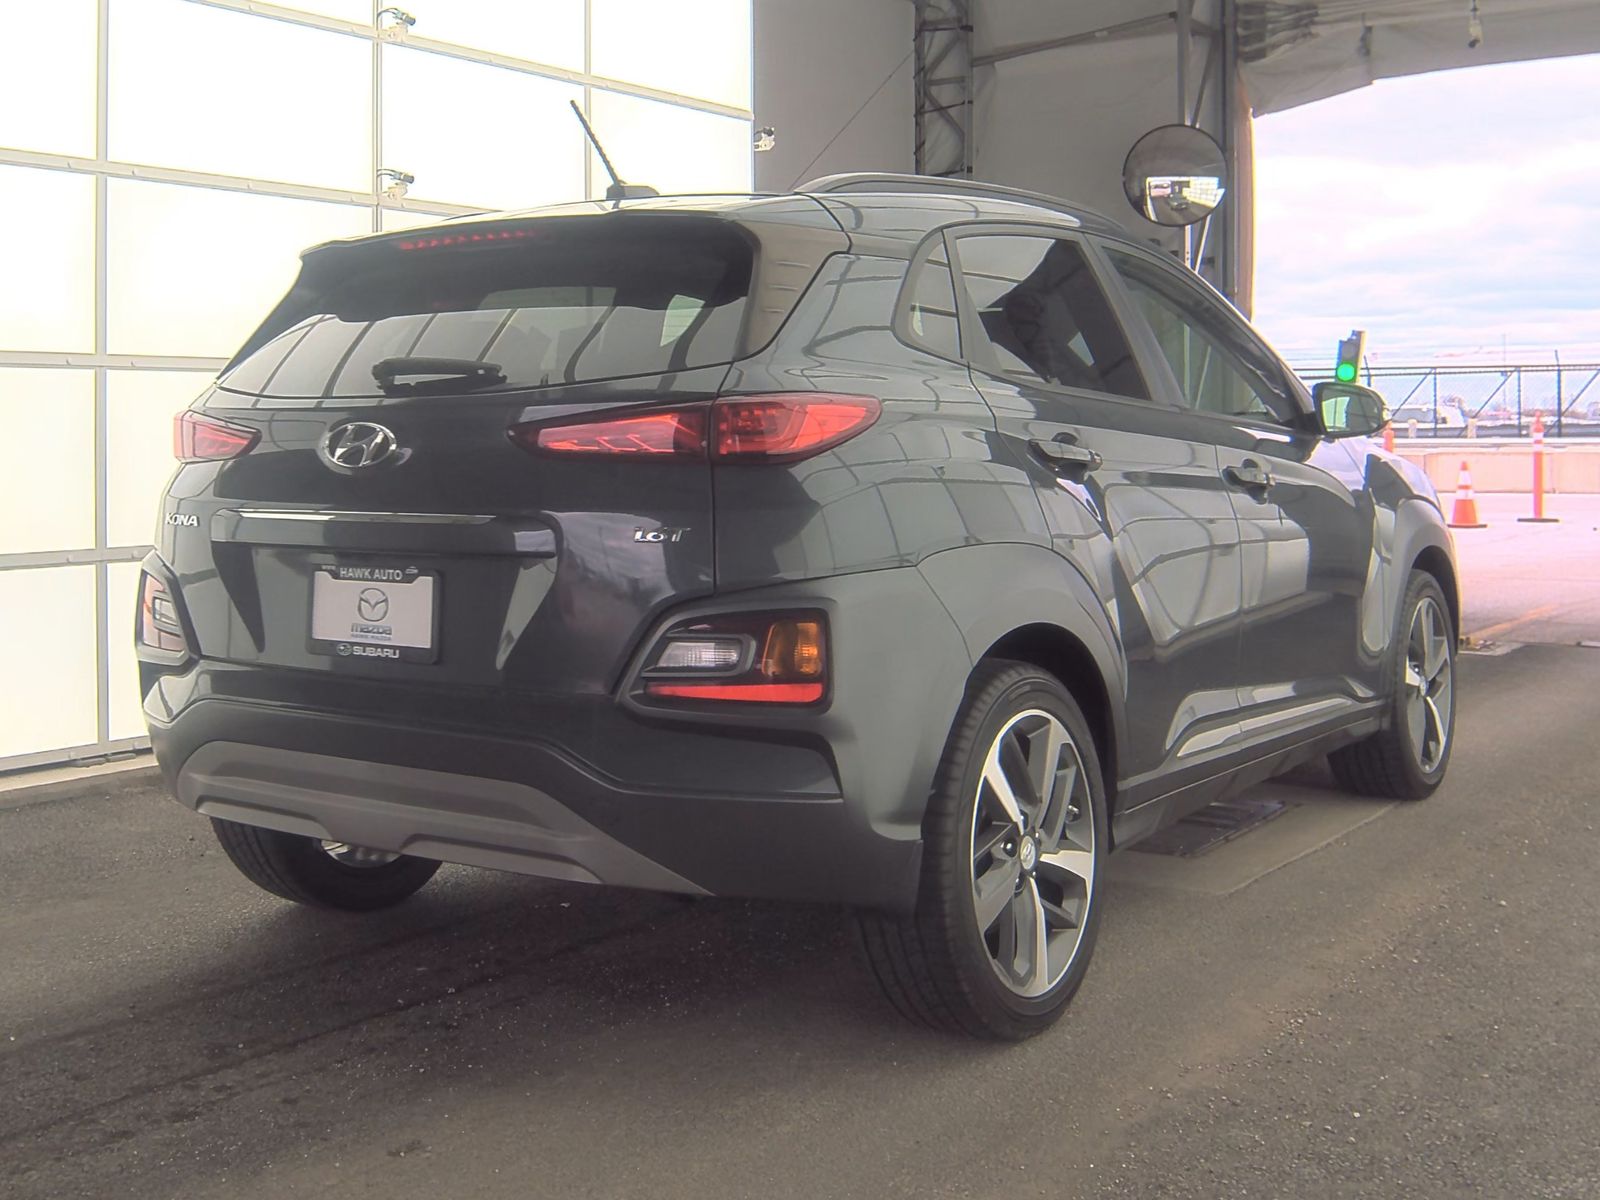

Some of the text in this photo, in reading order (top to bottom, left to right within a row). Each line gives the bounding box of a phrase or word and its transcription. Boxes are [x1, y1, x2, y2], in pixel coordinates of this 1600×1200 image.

[165, 513, 199, 527] KONA
[340, 568, 371, 579] HAWK
[374, 570, 403, 580] AUTO
[352, 646, 399, 658] SUBARU
